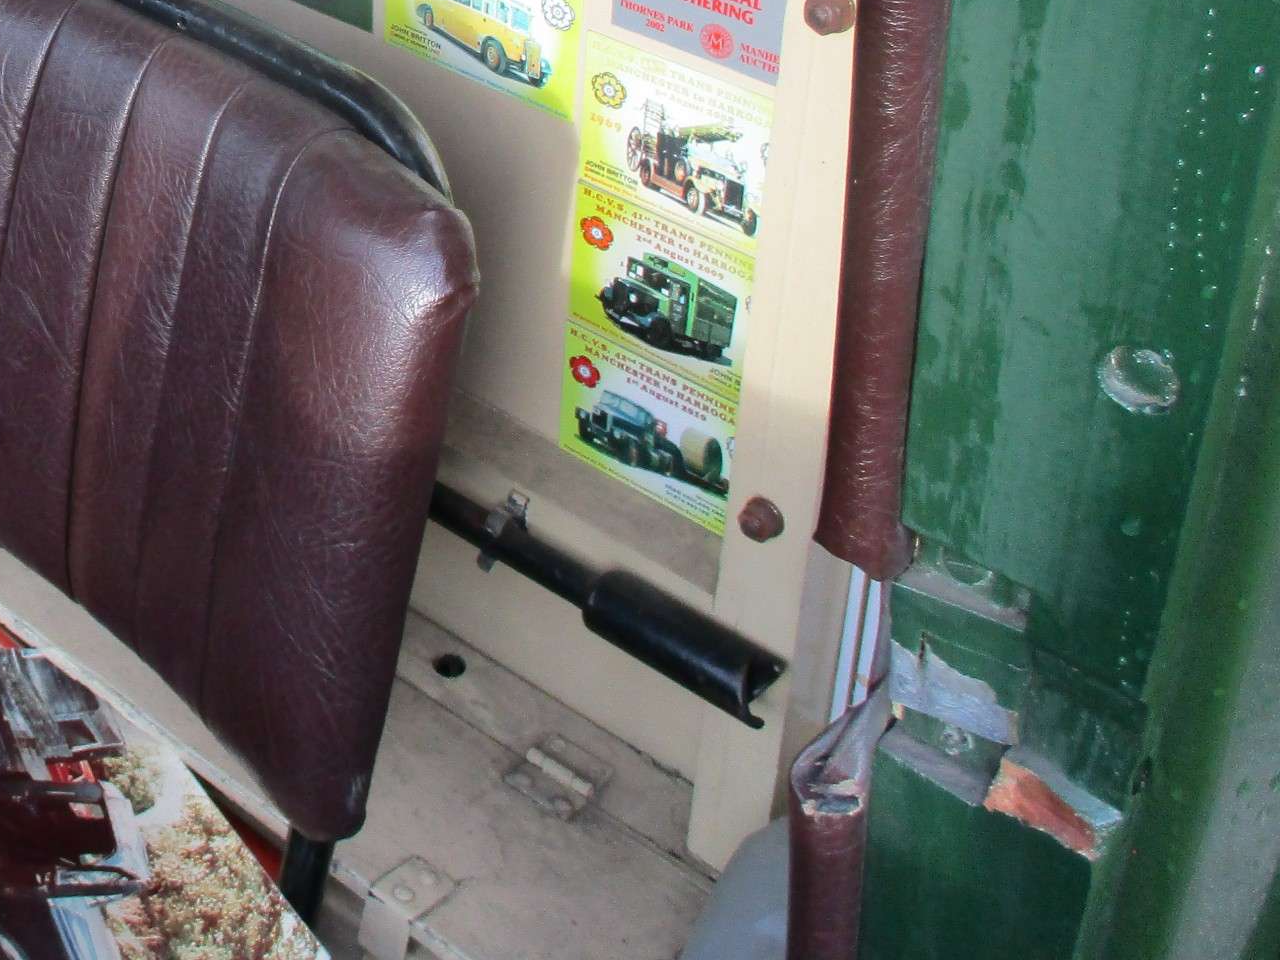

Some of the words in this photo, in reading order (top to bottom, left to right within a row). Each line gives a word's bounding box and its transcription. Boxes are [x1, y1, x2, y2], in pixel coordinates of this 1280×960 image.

[646, 19, 665, 33] 2002
[667, 16, 695, 33] PARK
[595, 204, 674, 245] MANCHESTER
[678, 242, 690, 253] to
[654, 218, 694, 244] TRANS
[654, 243, 695, 268] August
[584, 345, 661, 388] MANCHESTER
[664, 383, 674, 394] to
[638, 360, 678, 386] TRANS
[681, 383, 736, 414] PENNINE
[639, 384, 679, 406] August
